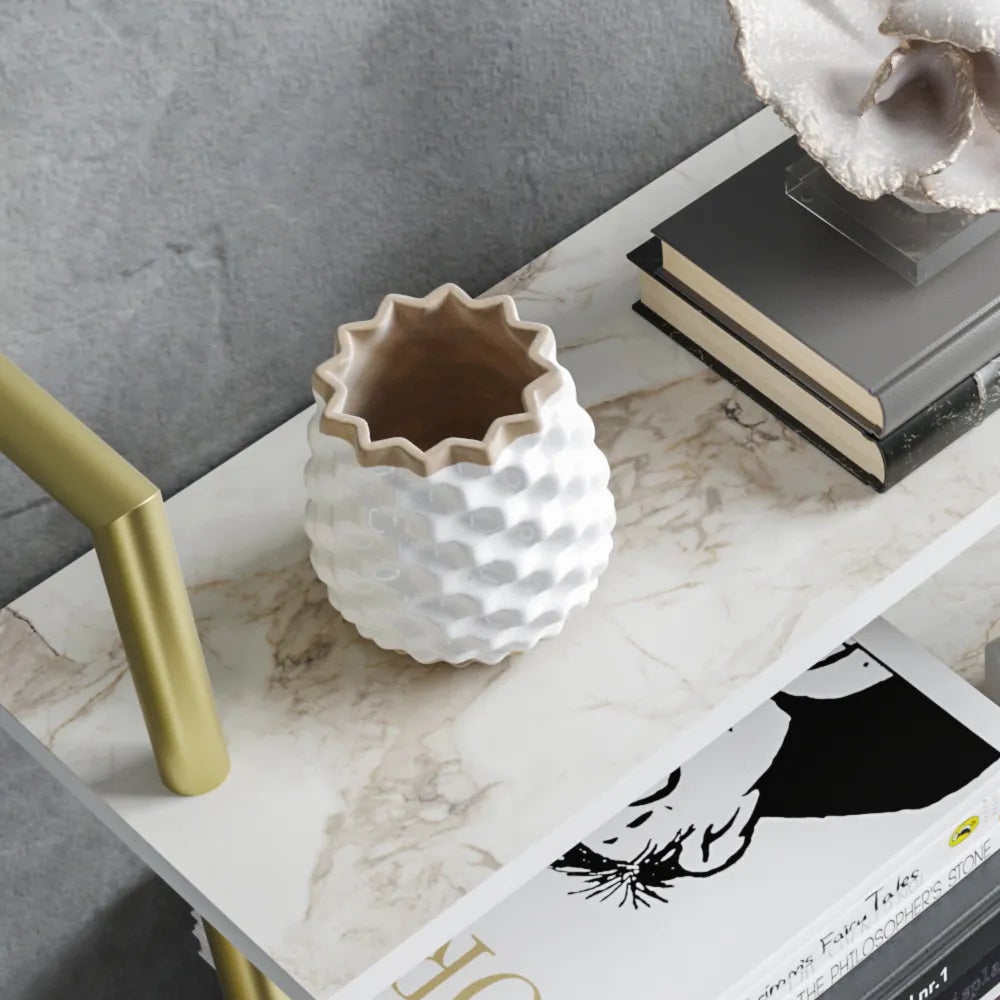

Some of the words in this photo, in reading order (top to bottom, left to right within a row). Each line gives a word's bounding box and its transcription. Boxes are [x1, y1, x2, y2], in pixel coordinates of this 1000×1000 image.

[829, 880, 943, 989] PHILOSOPHER'S
[947, 838, 994, 889] STONE
[864, 868, 921, 912] Tales
